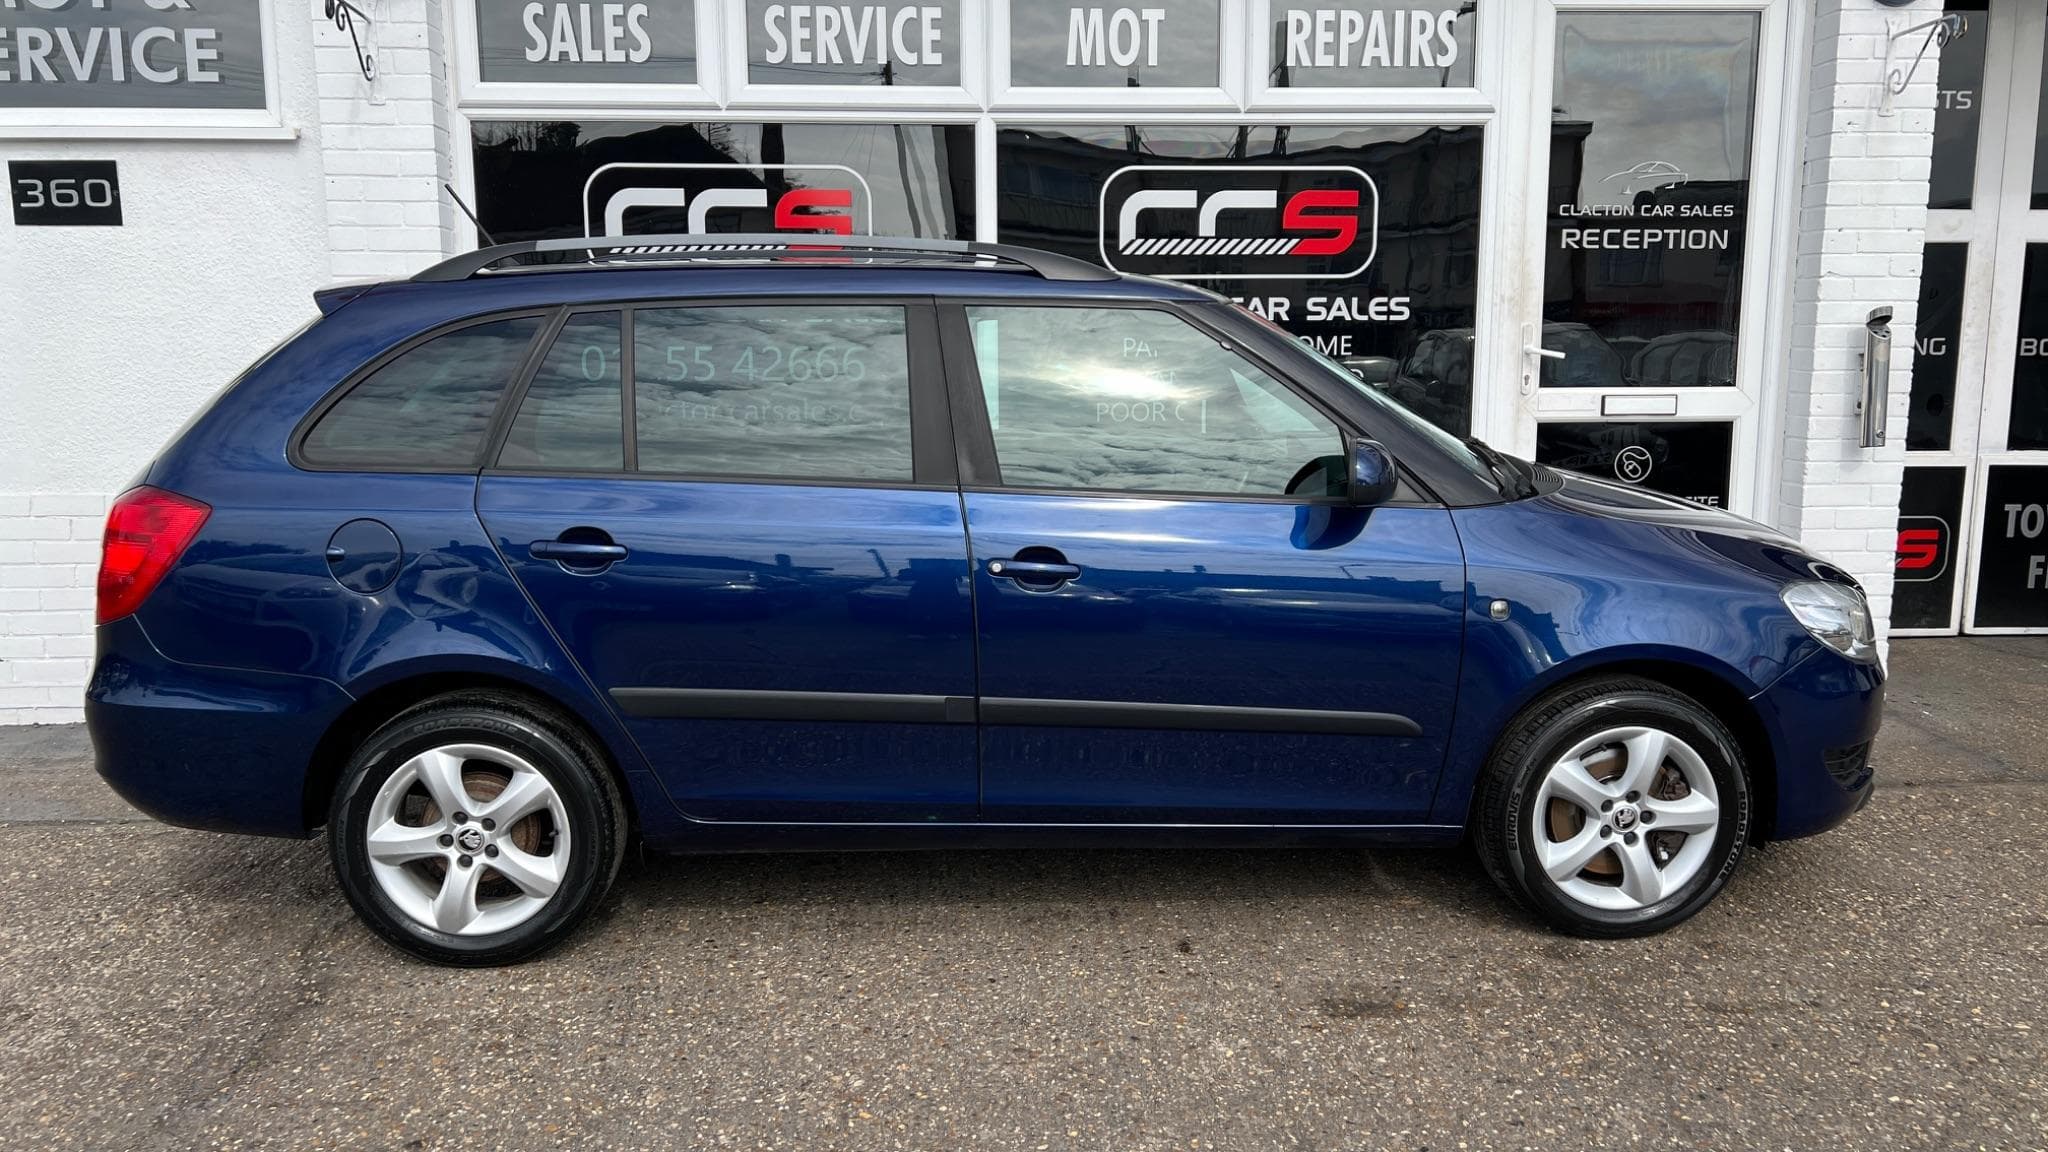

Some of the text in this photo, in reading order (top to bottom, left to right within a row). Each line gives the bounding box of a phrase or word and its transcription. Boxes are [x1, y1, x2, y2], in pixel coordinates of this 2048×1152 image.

[523, 2, 651, 63] SALES
[764, 4, 942, 66] SERVICE
[1066, 8, 1165, 67] MOT
[1286, 9, 1458, 68] REPAIRS
[18, 179, 113, 208] 360
[1559, 204, 1735, 218] CLACTON CAR SALES
[1561, 228, 1729, 250] RECEPTION
[1231, 296, 1410, 321] AR SALES
[1096, 401, 1166, 423] POOR
[2004, 503, 2048, 539] TO
